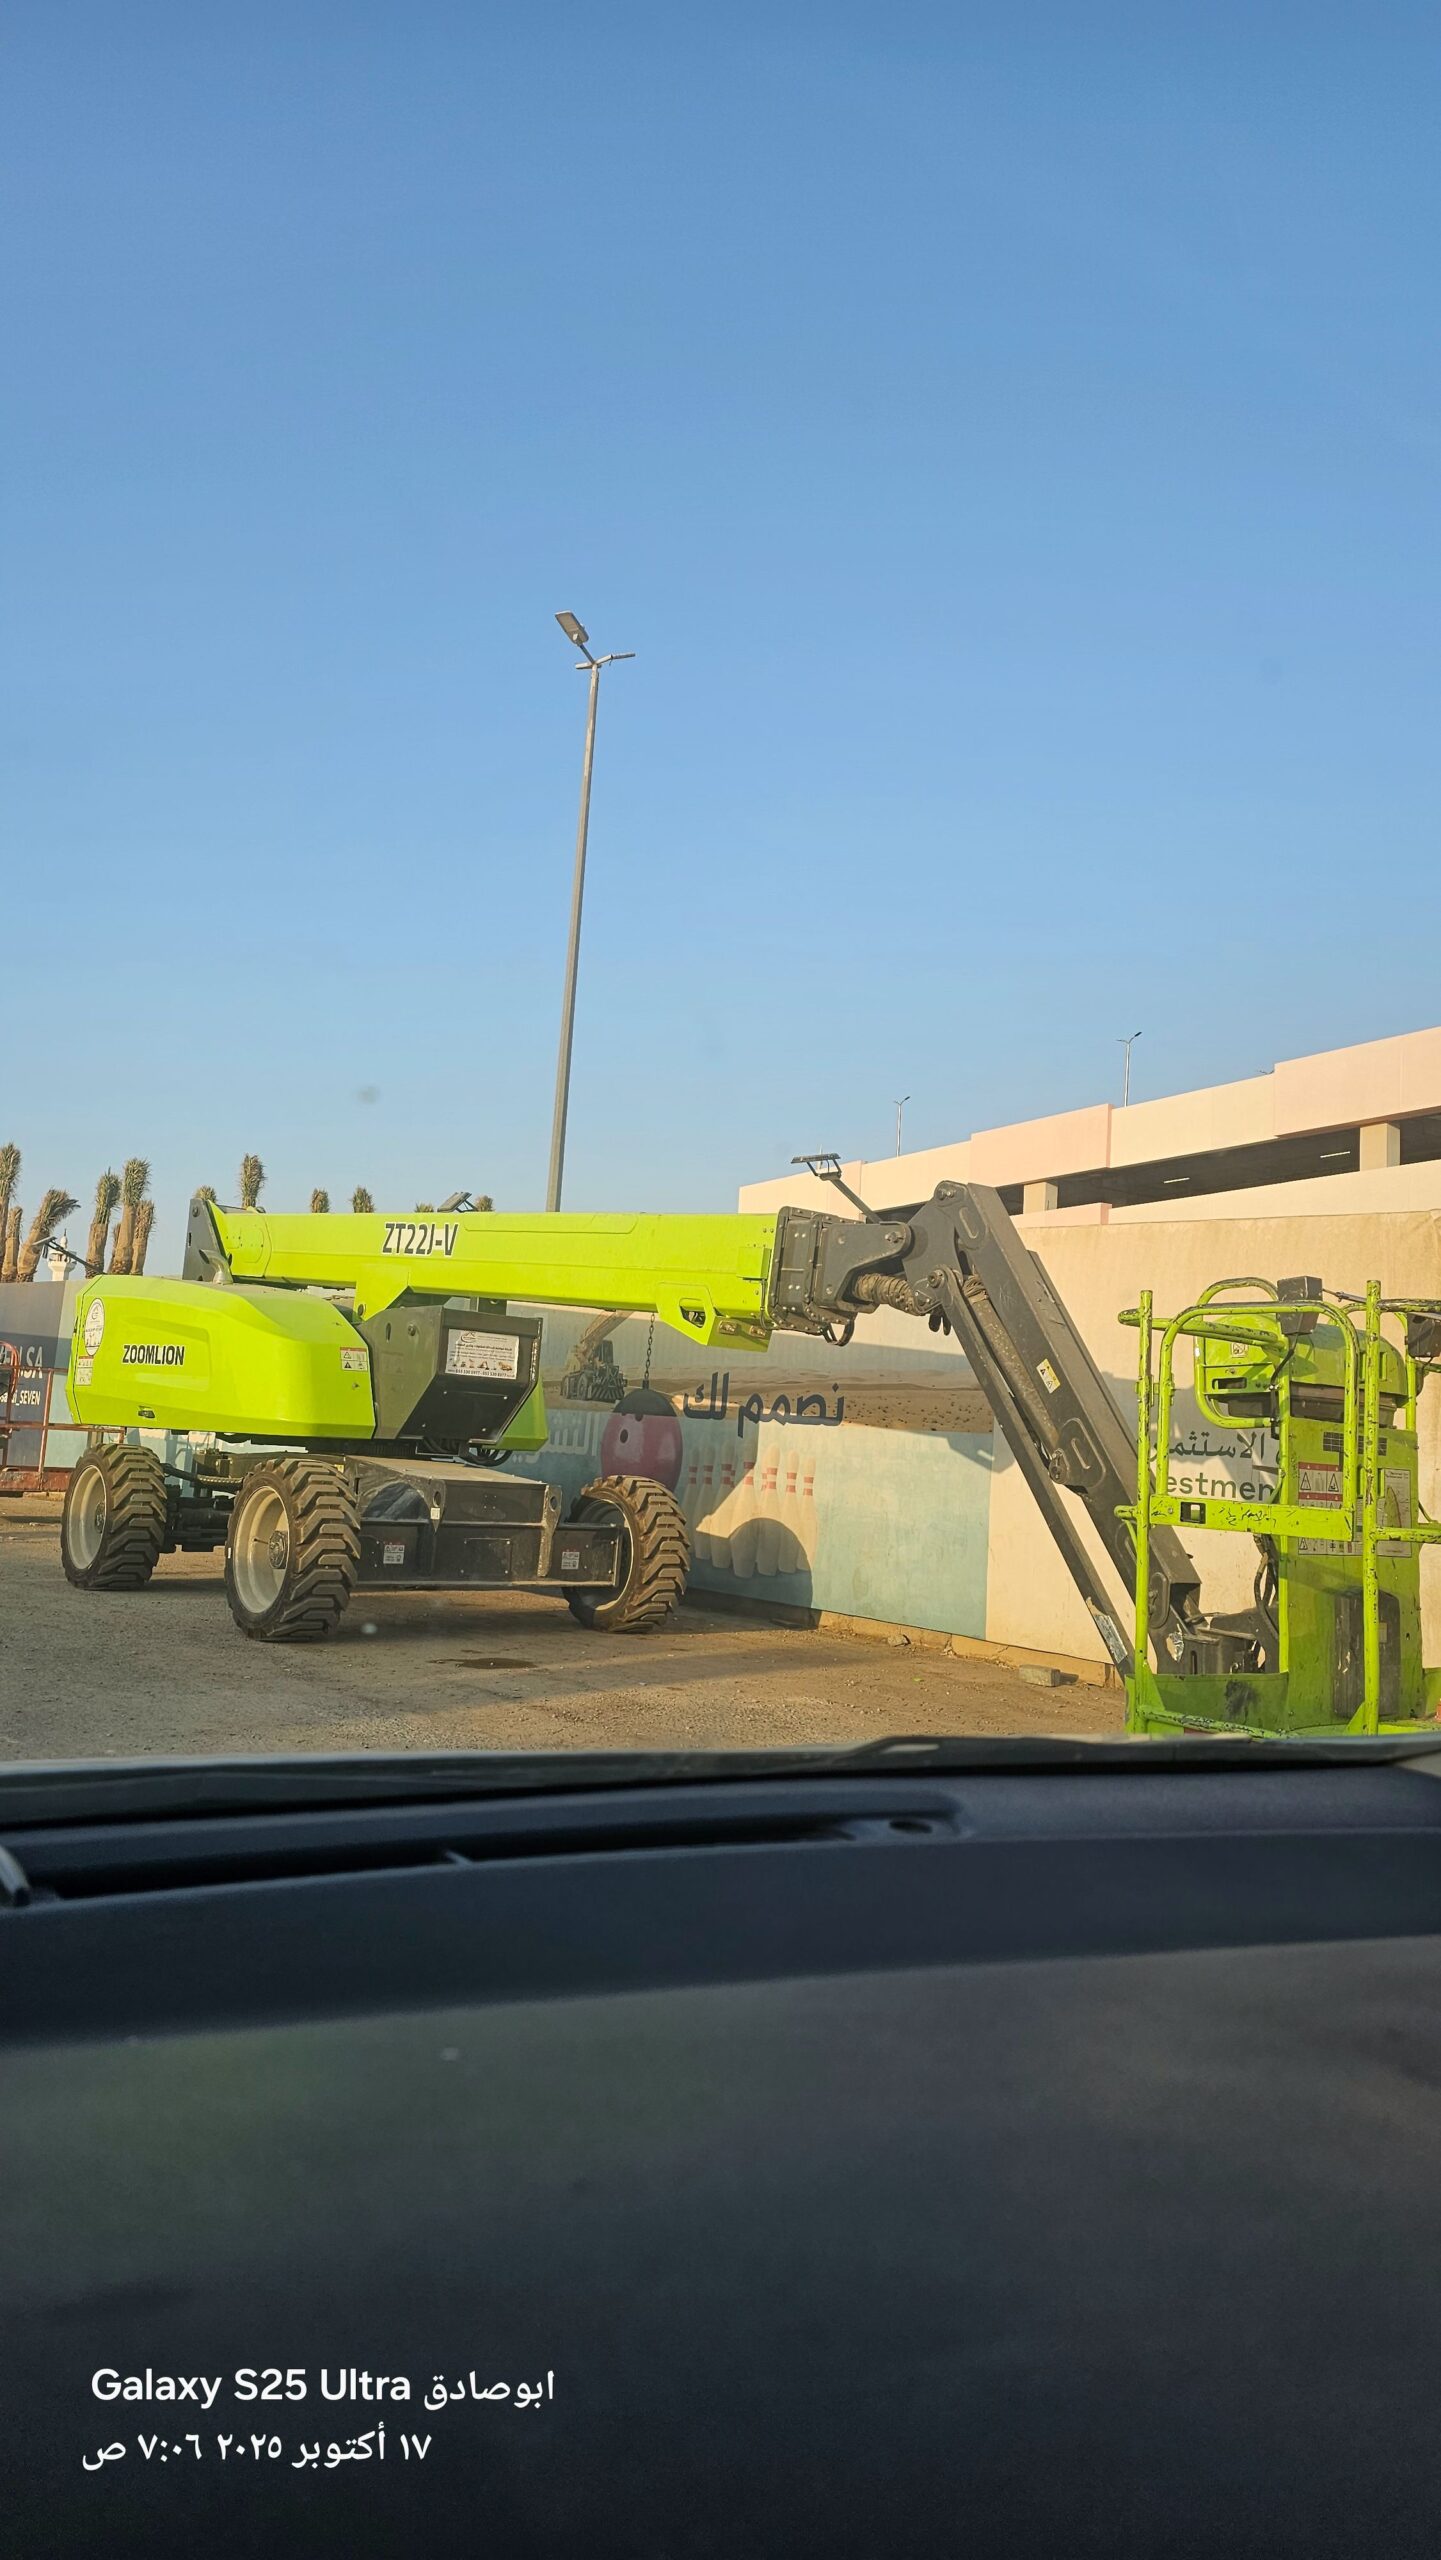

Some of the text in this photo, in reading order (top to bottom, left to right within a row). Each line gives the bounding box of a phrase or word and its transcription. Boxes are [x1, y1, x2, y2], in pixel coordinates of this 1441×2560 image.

[382, 1222, 459, 1256] ZT22J-V
[122, 1344, 185, 1366] ZOOMLION
[682, 1371, 845, 1439] نصمم لك
